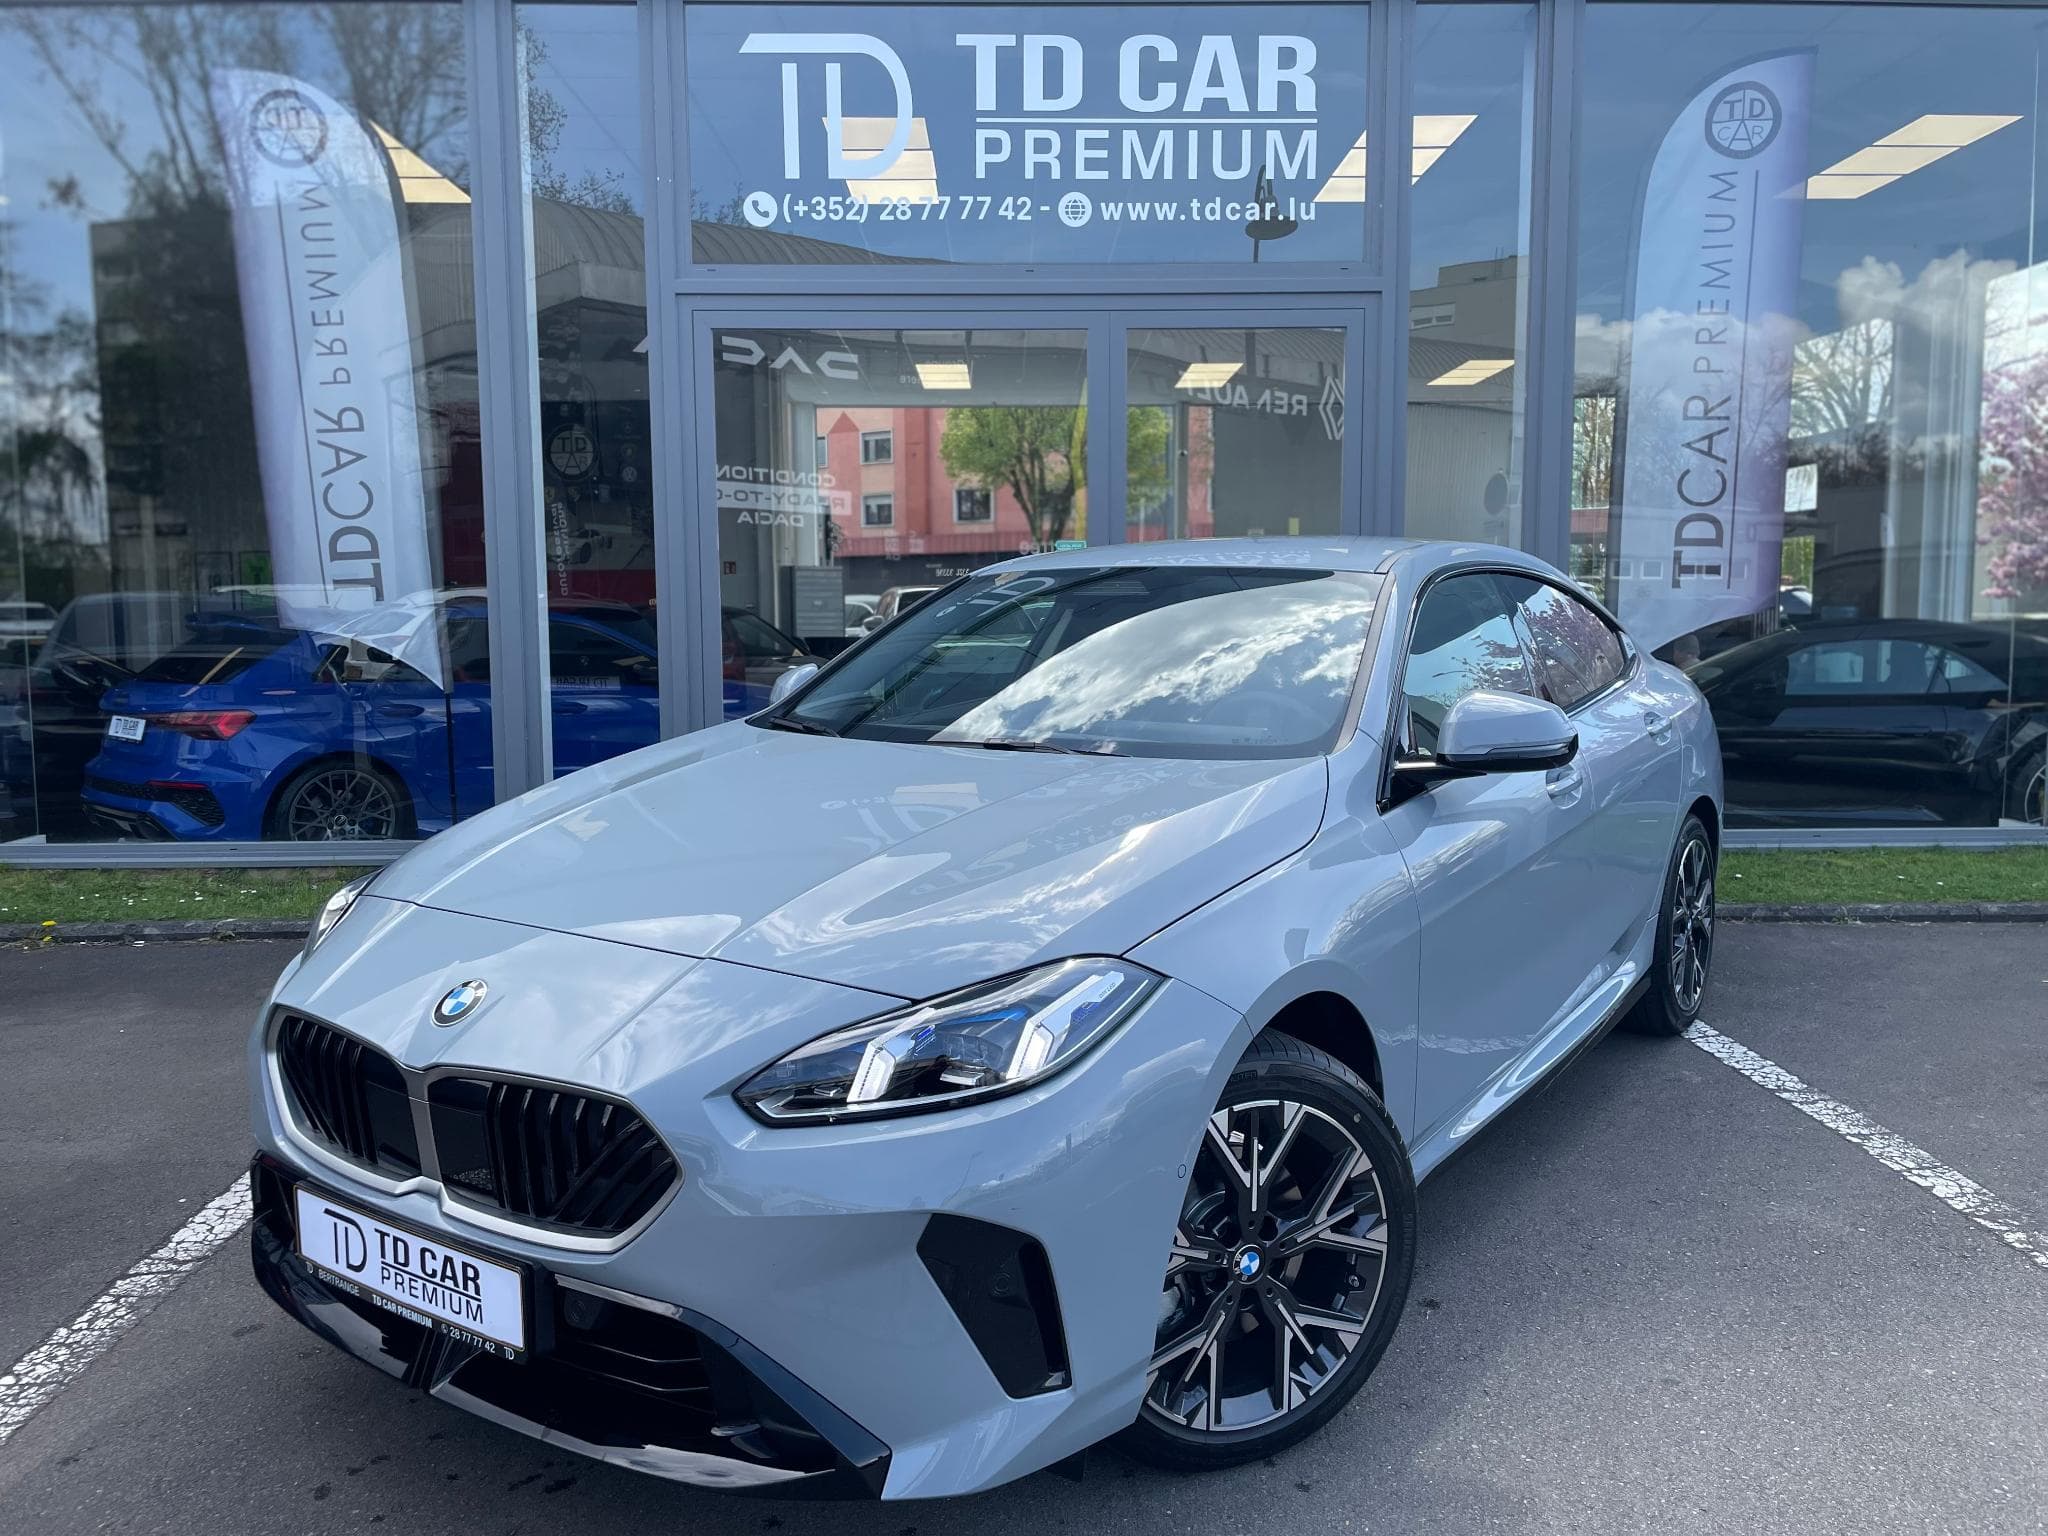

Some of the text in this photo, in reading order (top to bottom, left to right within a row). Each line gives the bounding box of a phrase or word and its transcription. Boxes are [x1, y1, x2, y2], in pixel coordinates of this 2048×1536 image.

[956, 34, 1317, 112] TD CAR
[1717, 120, 1764, 150] CAR
[1723, 98, 1766, 120] TD
[976, 129, 1318, 180] PREMIUM
[783, 194, 869, 223] (+352)
[879, 197, 911, 220] 28
[919, 197, 951, 220] 77
[959, 196, 992, 220] 77
[998, 197, 1032, 220] 42
[1100, 197, 1316, 220] www.tdcar.lu
[1672, 171, 1739, 589] TDCAR PREMIUM
[374, 1228, 481, 1297] TD CAR
[318, 1269, 360, 1297] BERTRANGE
[372, 1294, 382, 1306] TD
[382, 1298, 397, 1313] CAR
[397, 1305, 433, 1328] PREMIUM
[450, 1326, 461, 1340] 28
[461, 1331, 472, 1344] 77
[472, 1335, 484, 1348] 77
[484, 1341, 496, 1354] 42
[381, 1265, 484, 1324] PREMIUM
